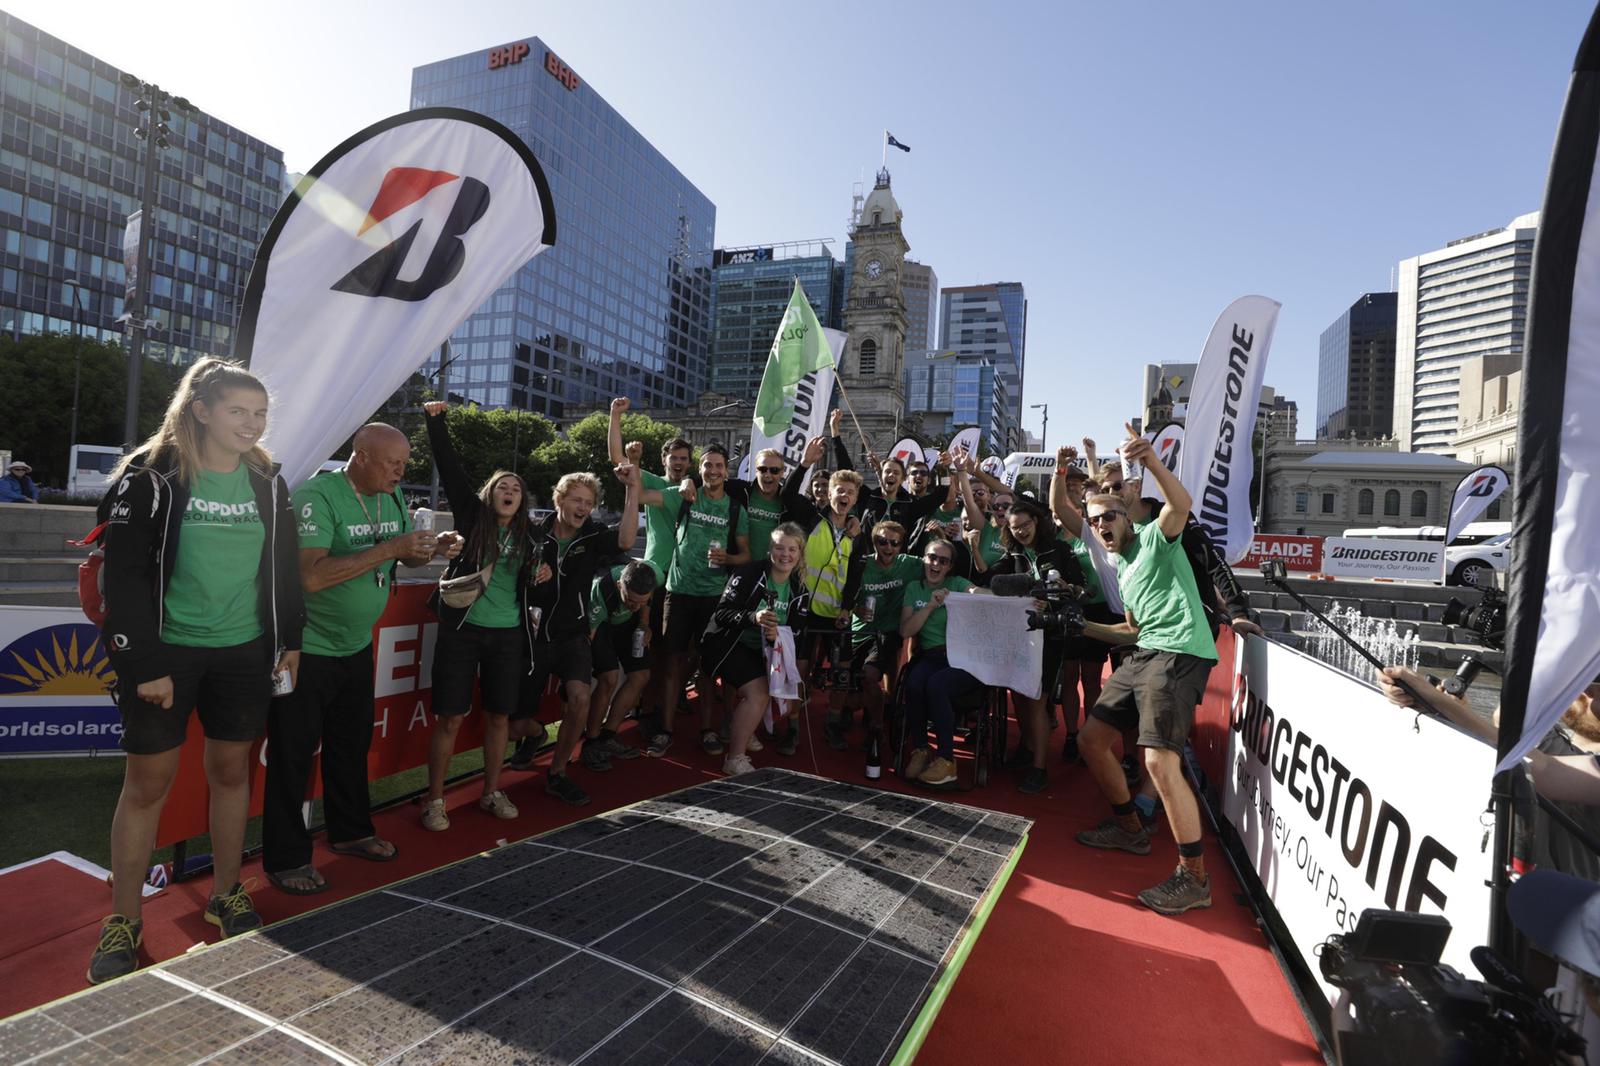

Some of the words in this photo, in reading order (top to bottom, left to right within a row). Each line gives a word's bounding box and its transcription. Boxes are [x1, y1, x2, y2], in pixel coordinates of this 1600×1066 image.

[487, 42, 530, 70] BHP
[545, 52, 580, 92] BHP
[729, 252, 755, 265] ANZ
[186, 497, 259, 516] TOPDUT
[302, 503, 313, 518] 6
[1331, 546, 1439, 563] BRIDGESTONE
[1402, 564, 1431, 572] Passion
[1296, 836, 1325, 891] Our
